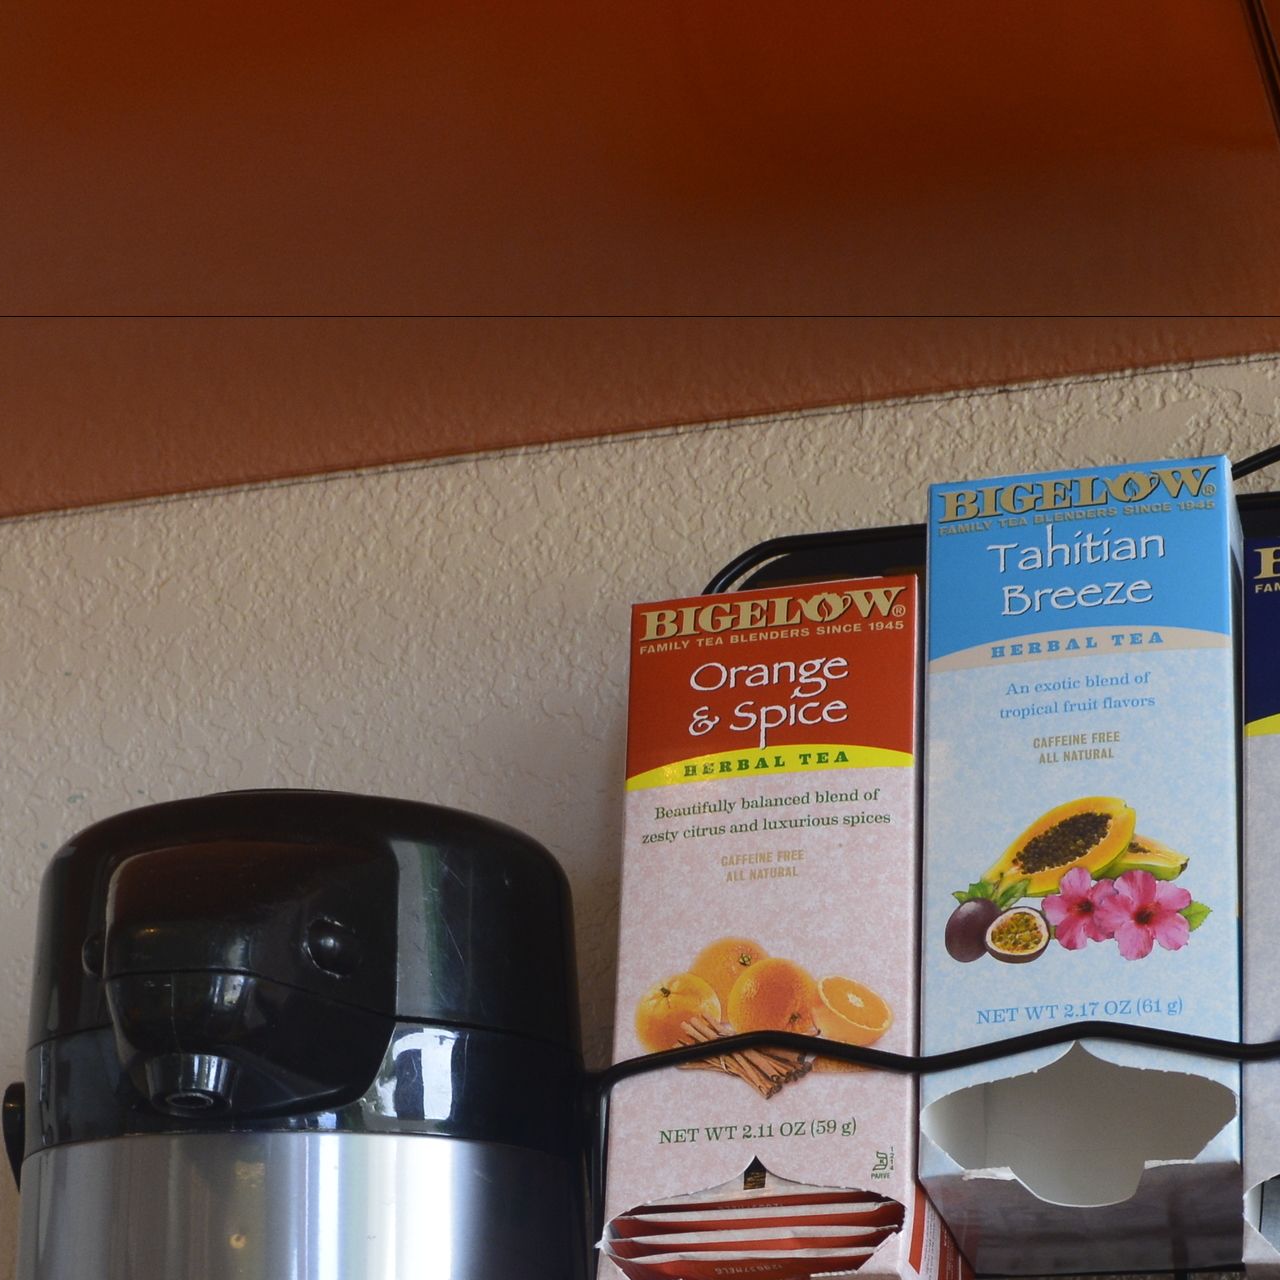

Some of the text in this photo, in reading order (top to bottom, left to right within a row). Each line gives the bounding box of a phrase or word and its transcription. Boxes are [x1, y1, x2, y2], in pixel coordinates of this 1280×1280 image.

[938, 466, 1216, 522] BIGELOW
[987, 524, 1165, 574] Tahitian
[640, 586, 907, 643] BIGELOW
[1002, 580, 1153, 616] Breeze
[640, 621, 904, 654] FAMILY TEA BLENDERS SINCE 1945
[991, 632, 1163, 658] HERBAL TEA
[690, 657, 848, 699] Orange
[1006, 672, 1151, 695] An exotic blend of
[689, 694, 848, 748] & Spice
[1000, 697, 1155, 719] tropical fruit flavors
[684, 751, 848, 776] HERBAL TEA
[659, 1128, 699, 1144] NET
[705, 1126, 737, 1141] WT
[742, 1124, 774, 1139] 2.11
[780, 1122, 805, 1136] OZ
